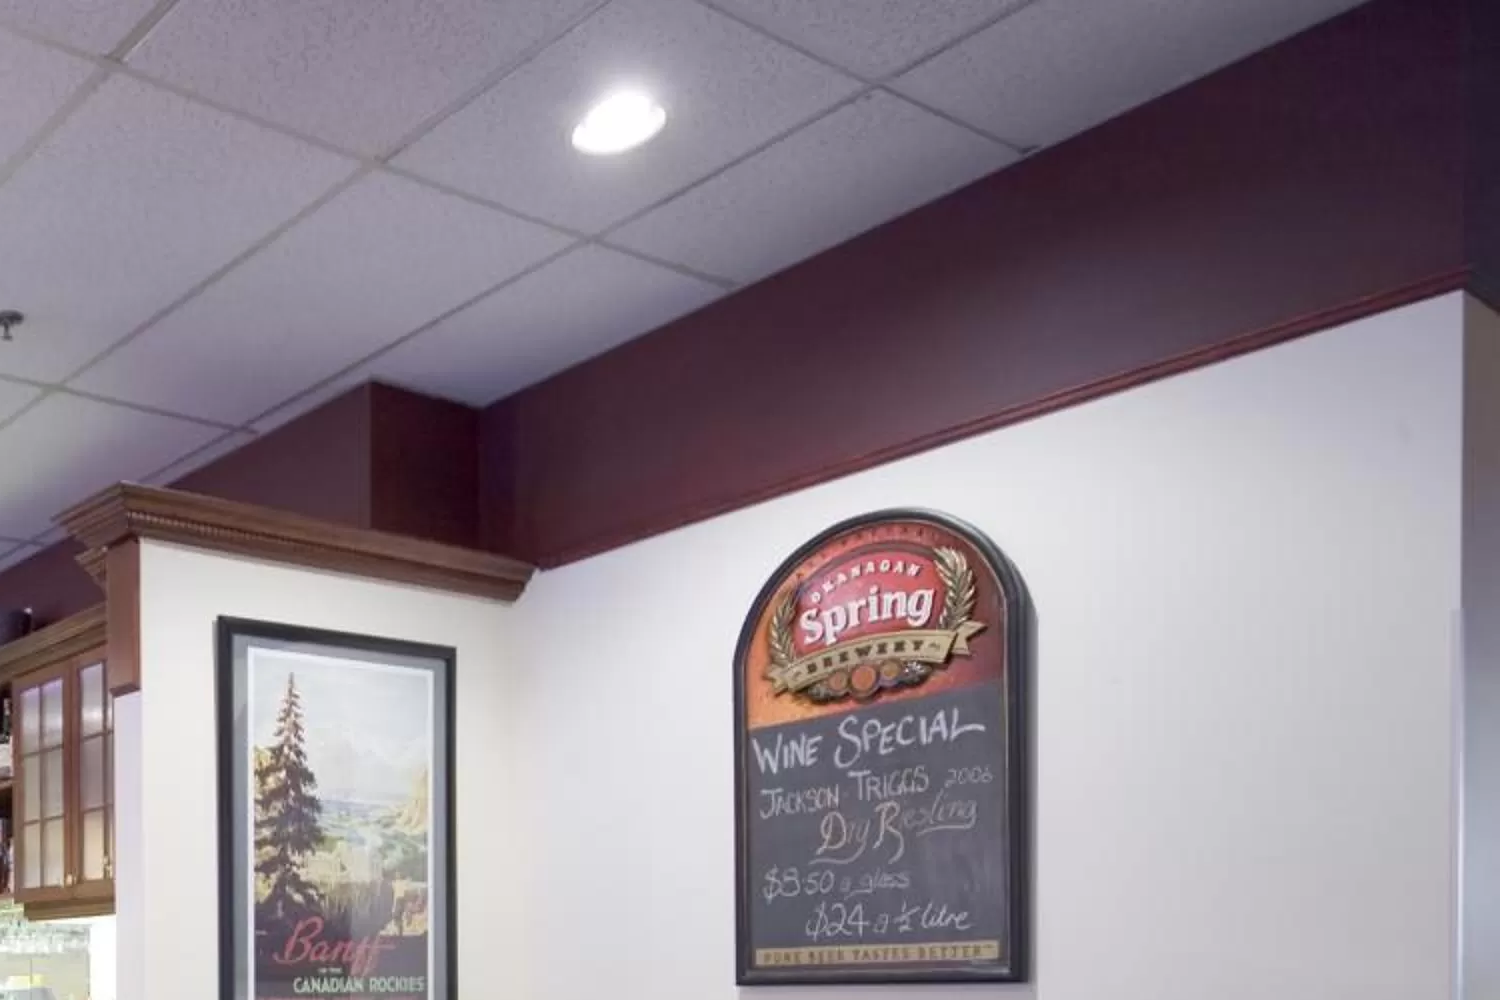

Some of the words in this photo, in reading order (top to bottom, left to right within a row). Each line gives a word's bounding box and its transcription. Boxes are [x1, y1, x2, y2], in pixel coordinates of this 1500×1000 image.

[800, 585, 935, 645] Spring
[753, 734, 823, 774] WINE
[834, 707, 986, 768] SPECIAL
[848, 765, 929, 800] TRIGGS
[272, 915, 396, 977] Banff
[806, 901, 870, 941] $24
[293, 976, 364, 994] CANADIAN
[369, 976, 425, 993] ROCKIES
